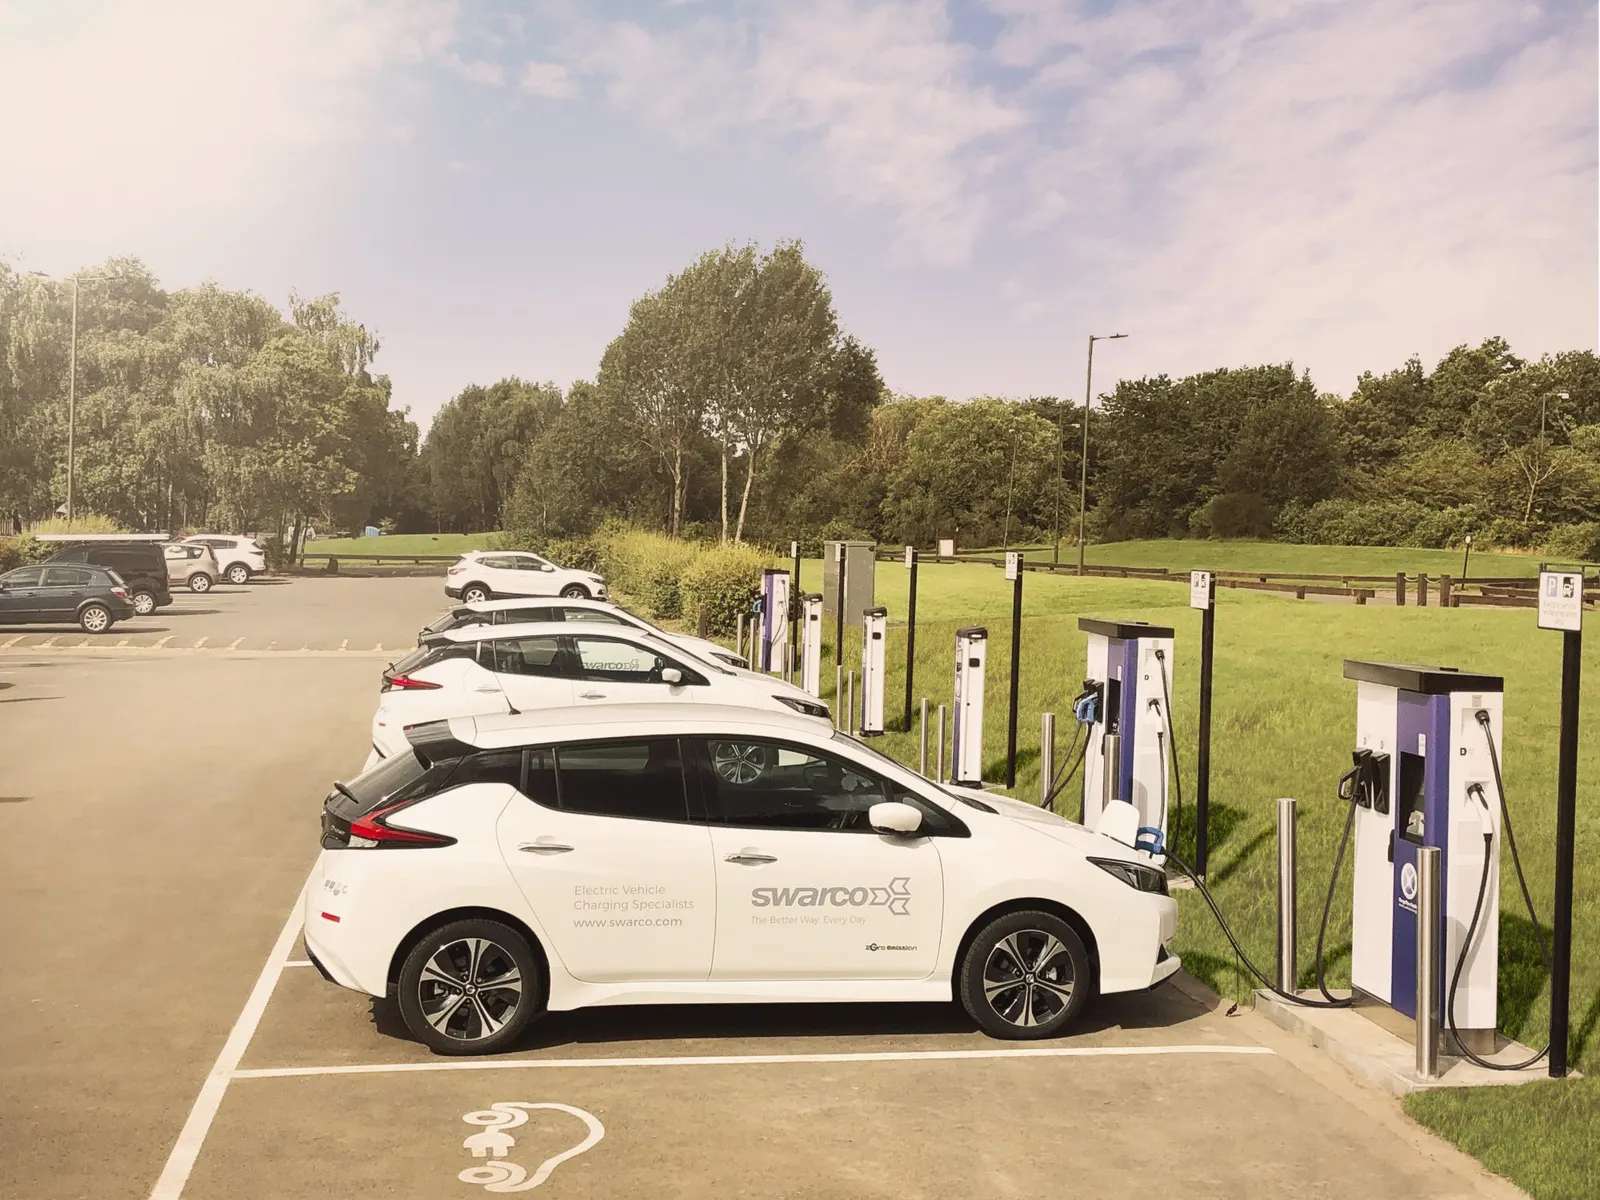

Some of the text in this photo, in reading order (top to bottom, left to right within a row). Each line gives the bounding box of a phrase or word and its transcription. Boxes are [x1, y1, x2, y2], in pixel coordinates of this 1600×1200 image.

[574, 884, 666, 896] Electric Vehicle
[751, 886, 869, 907] swarco
[573, 898, 694, 912] Charging Specialists
[573, 918, 683, 928] www.swarco.com
[751, 916, 767, 924] The
[769, 916, 798, 924] Better
[823, 915, 847, 925] Every
